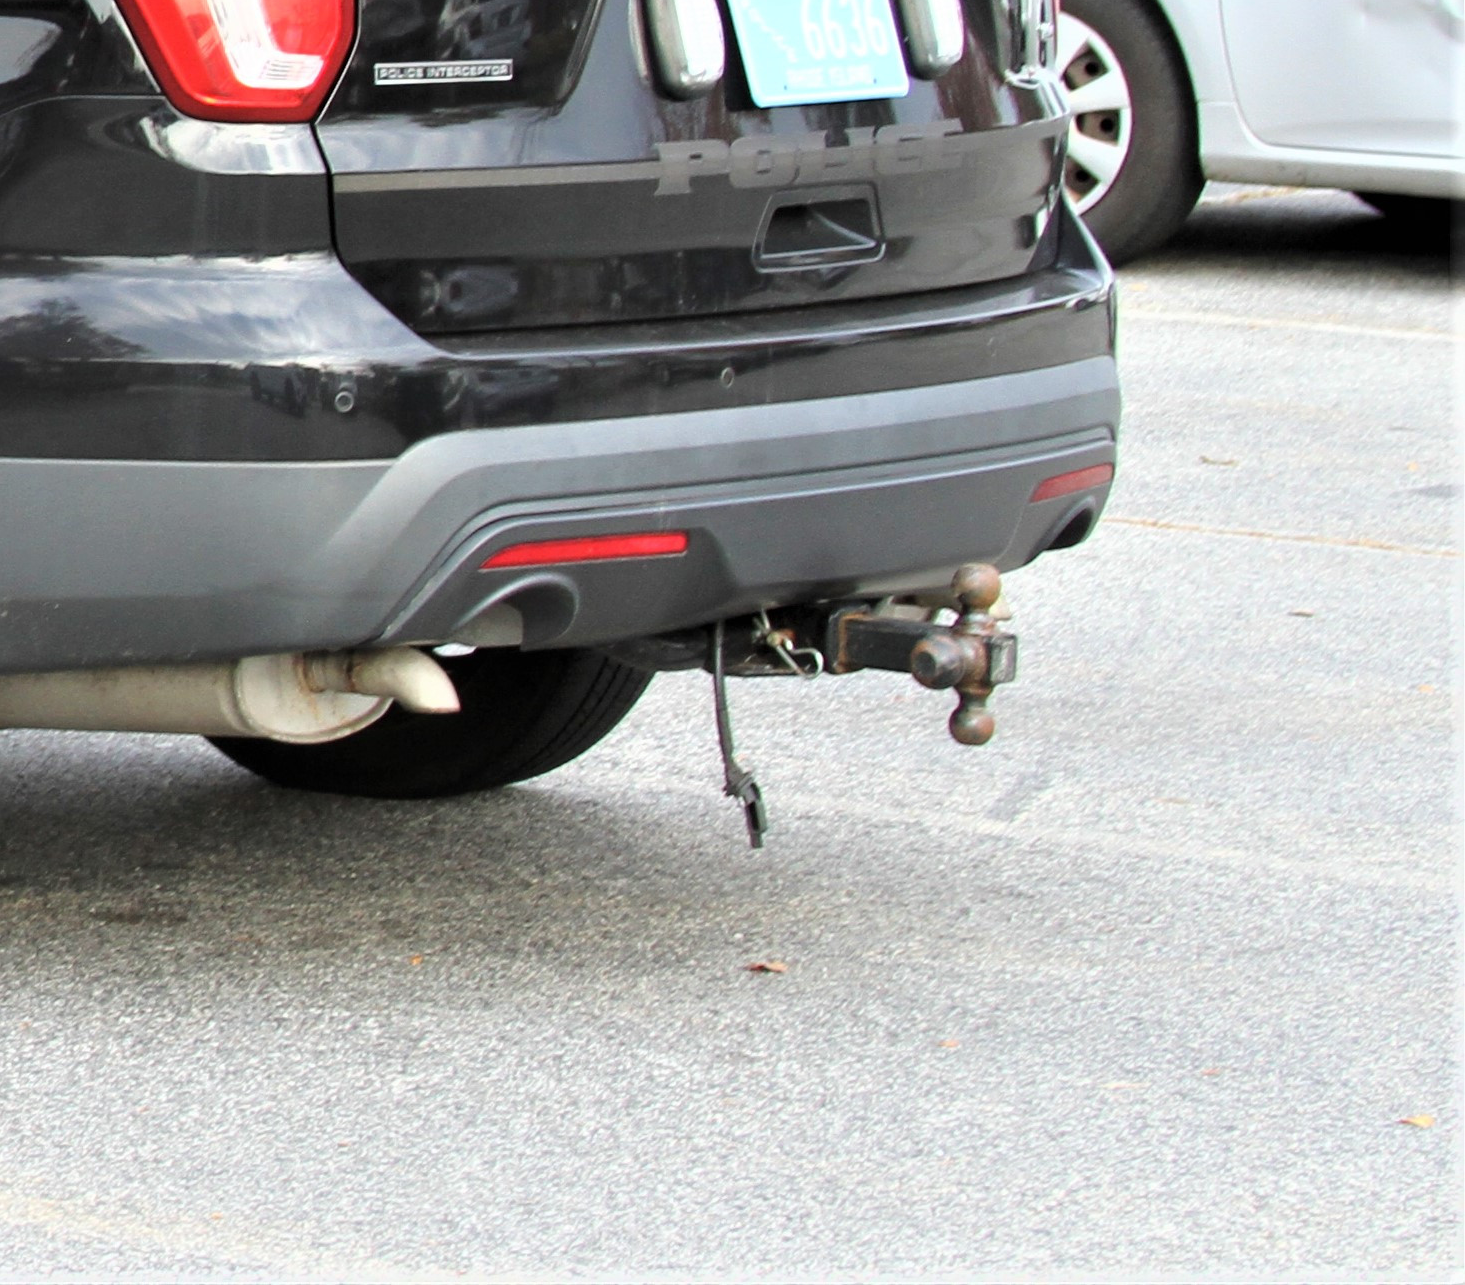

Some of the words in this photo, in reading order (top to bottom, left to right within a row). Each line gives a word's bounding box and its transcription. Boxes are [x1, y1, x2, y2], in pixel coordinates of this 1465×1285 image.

[379, 67, 424, 79] POLICE
[426, 64, 509, 78] INTERCEPTOR
[654, 118, 967, 196] POLICE
